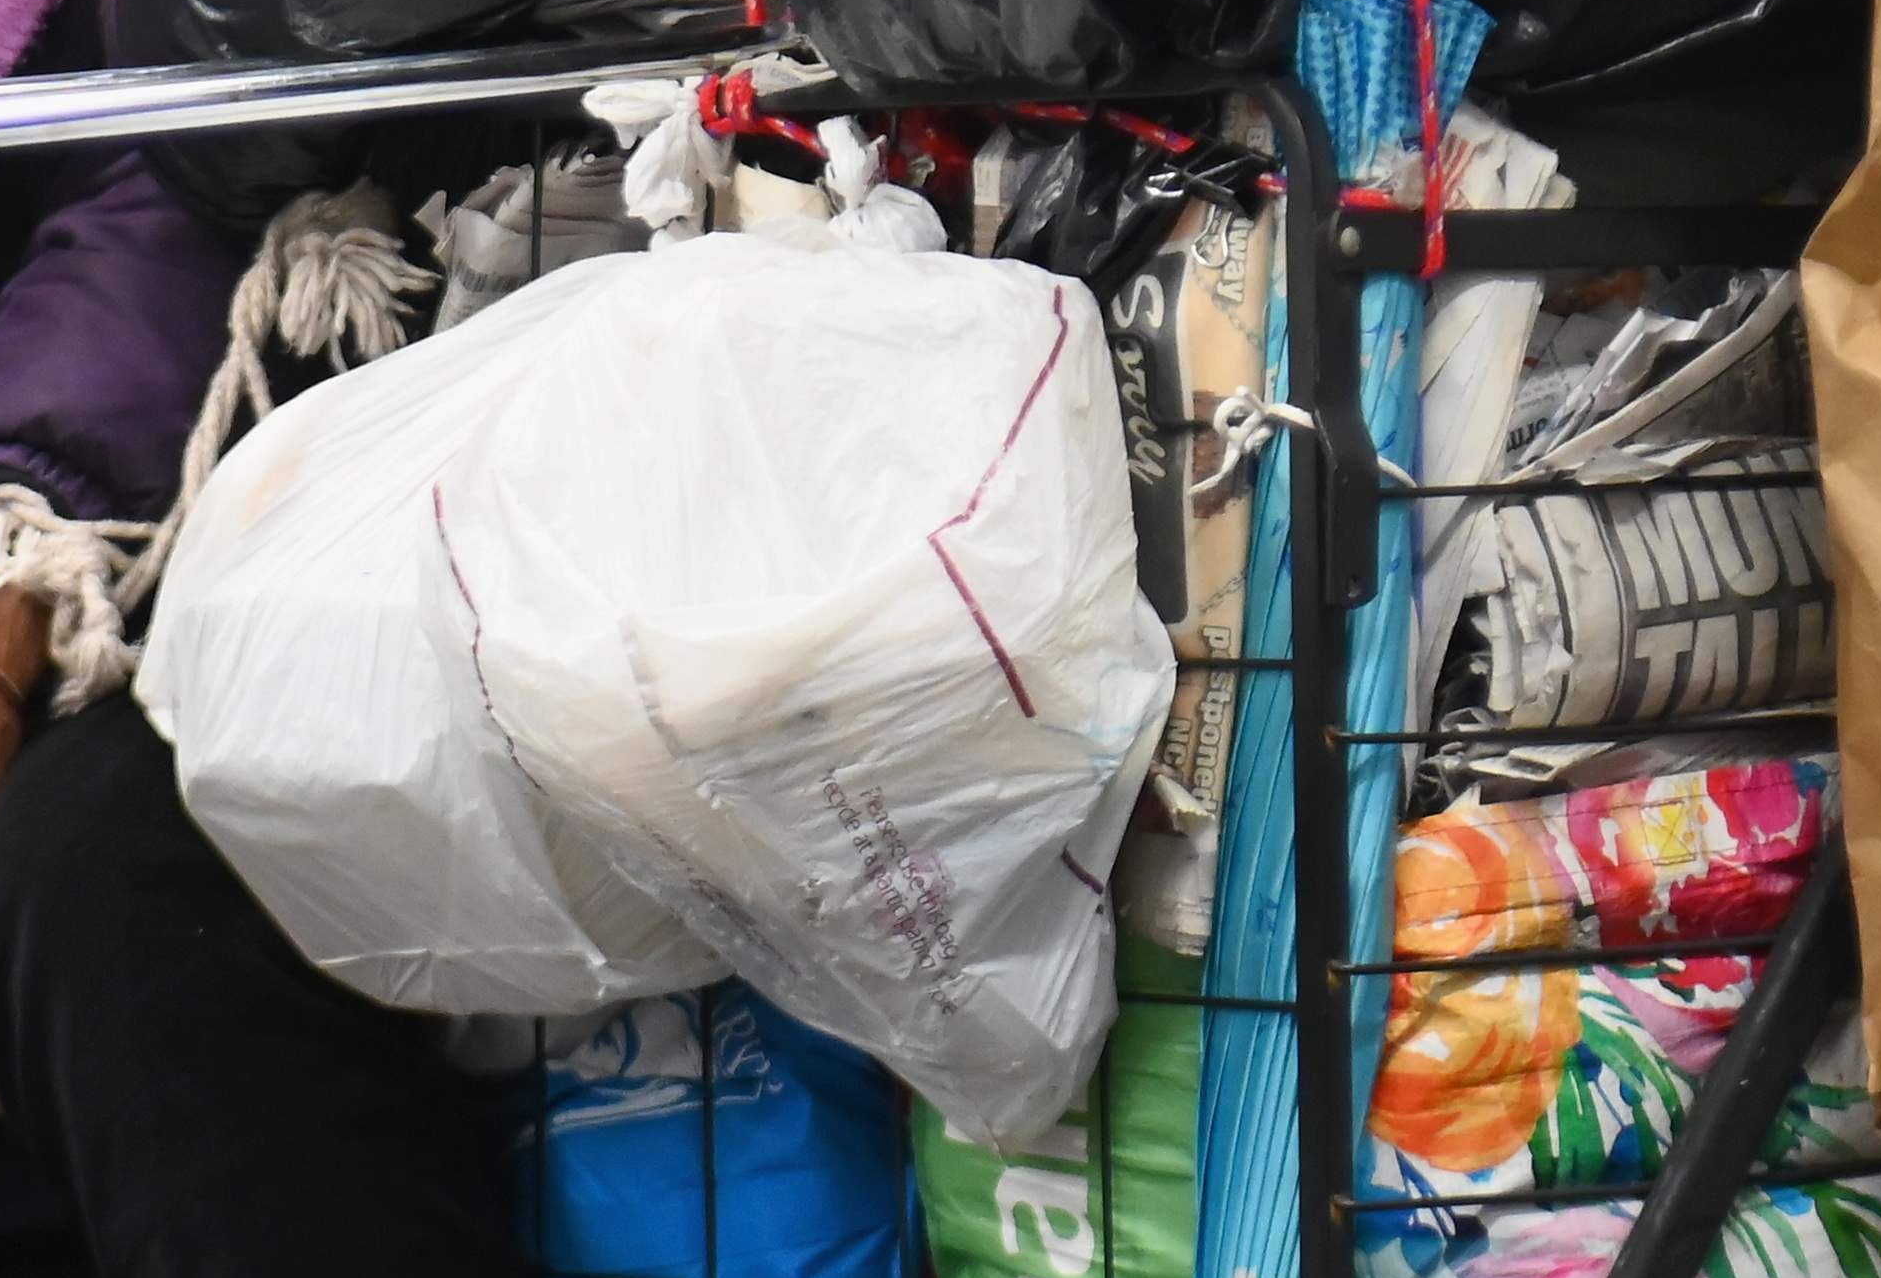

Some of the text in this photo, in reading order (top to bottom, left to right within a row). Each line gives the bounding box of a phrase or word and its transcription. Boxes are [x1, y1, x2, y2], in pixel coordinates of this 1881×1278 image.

[819, 770, 863, 833] recycle
[853, 833, 875, 855] at
[933, 918, 962, 960] bag
